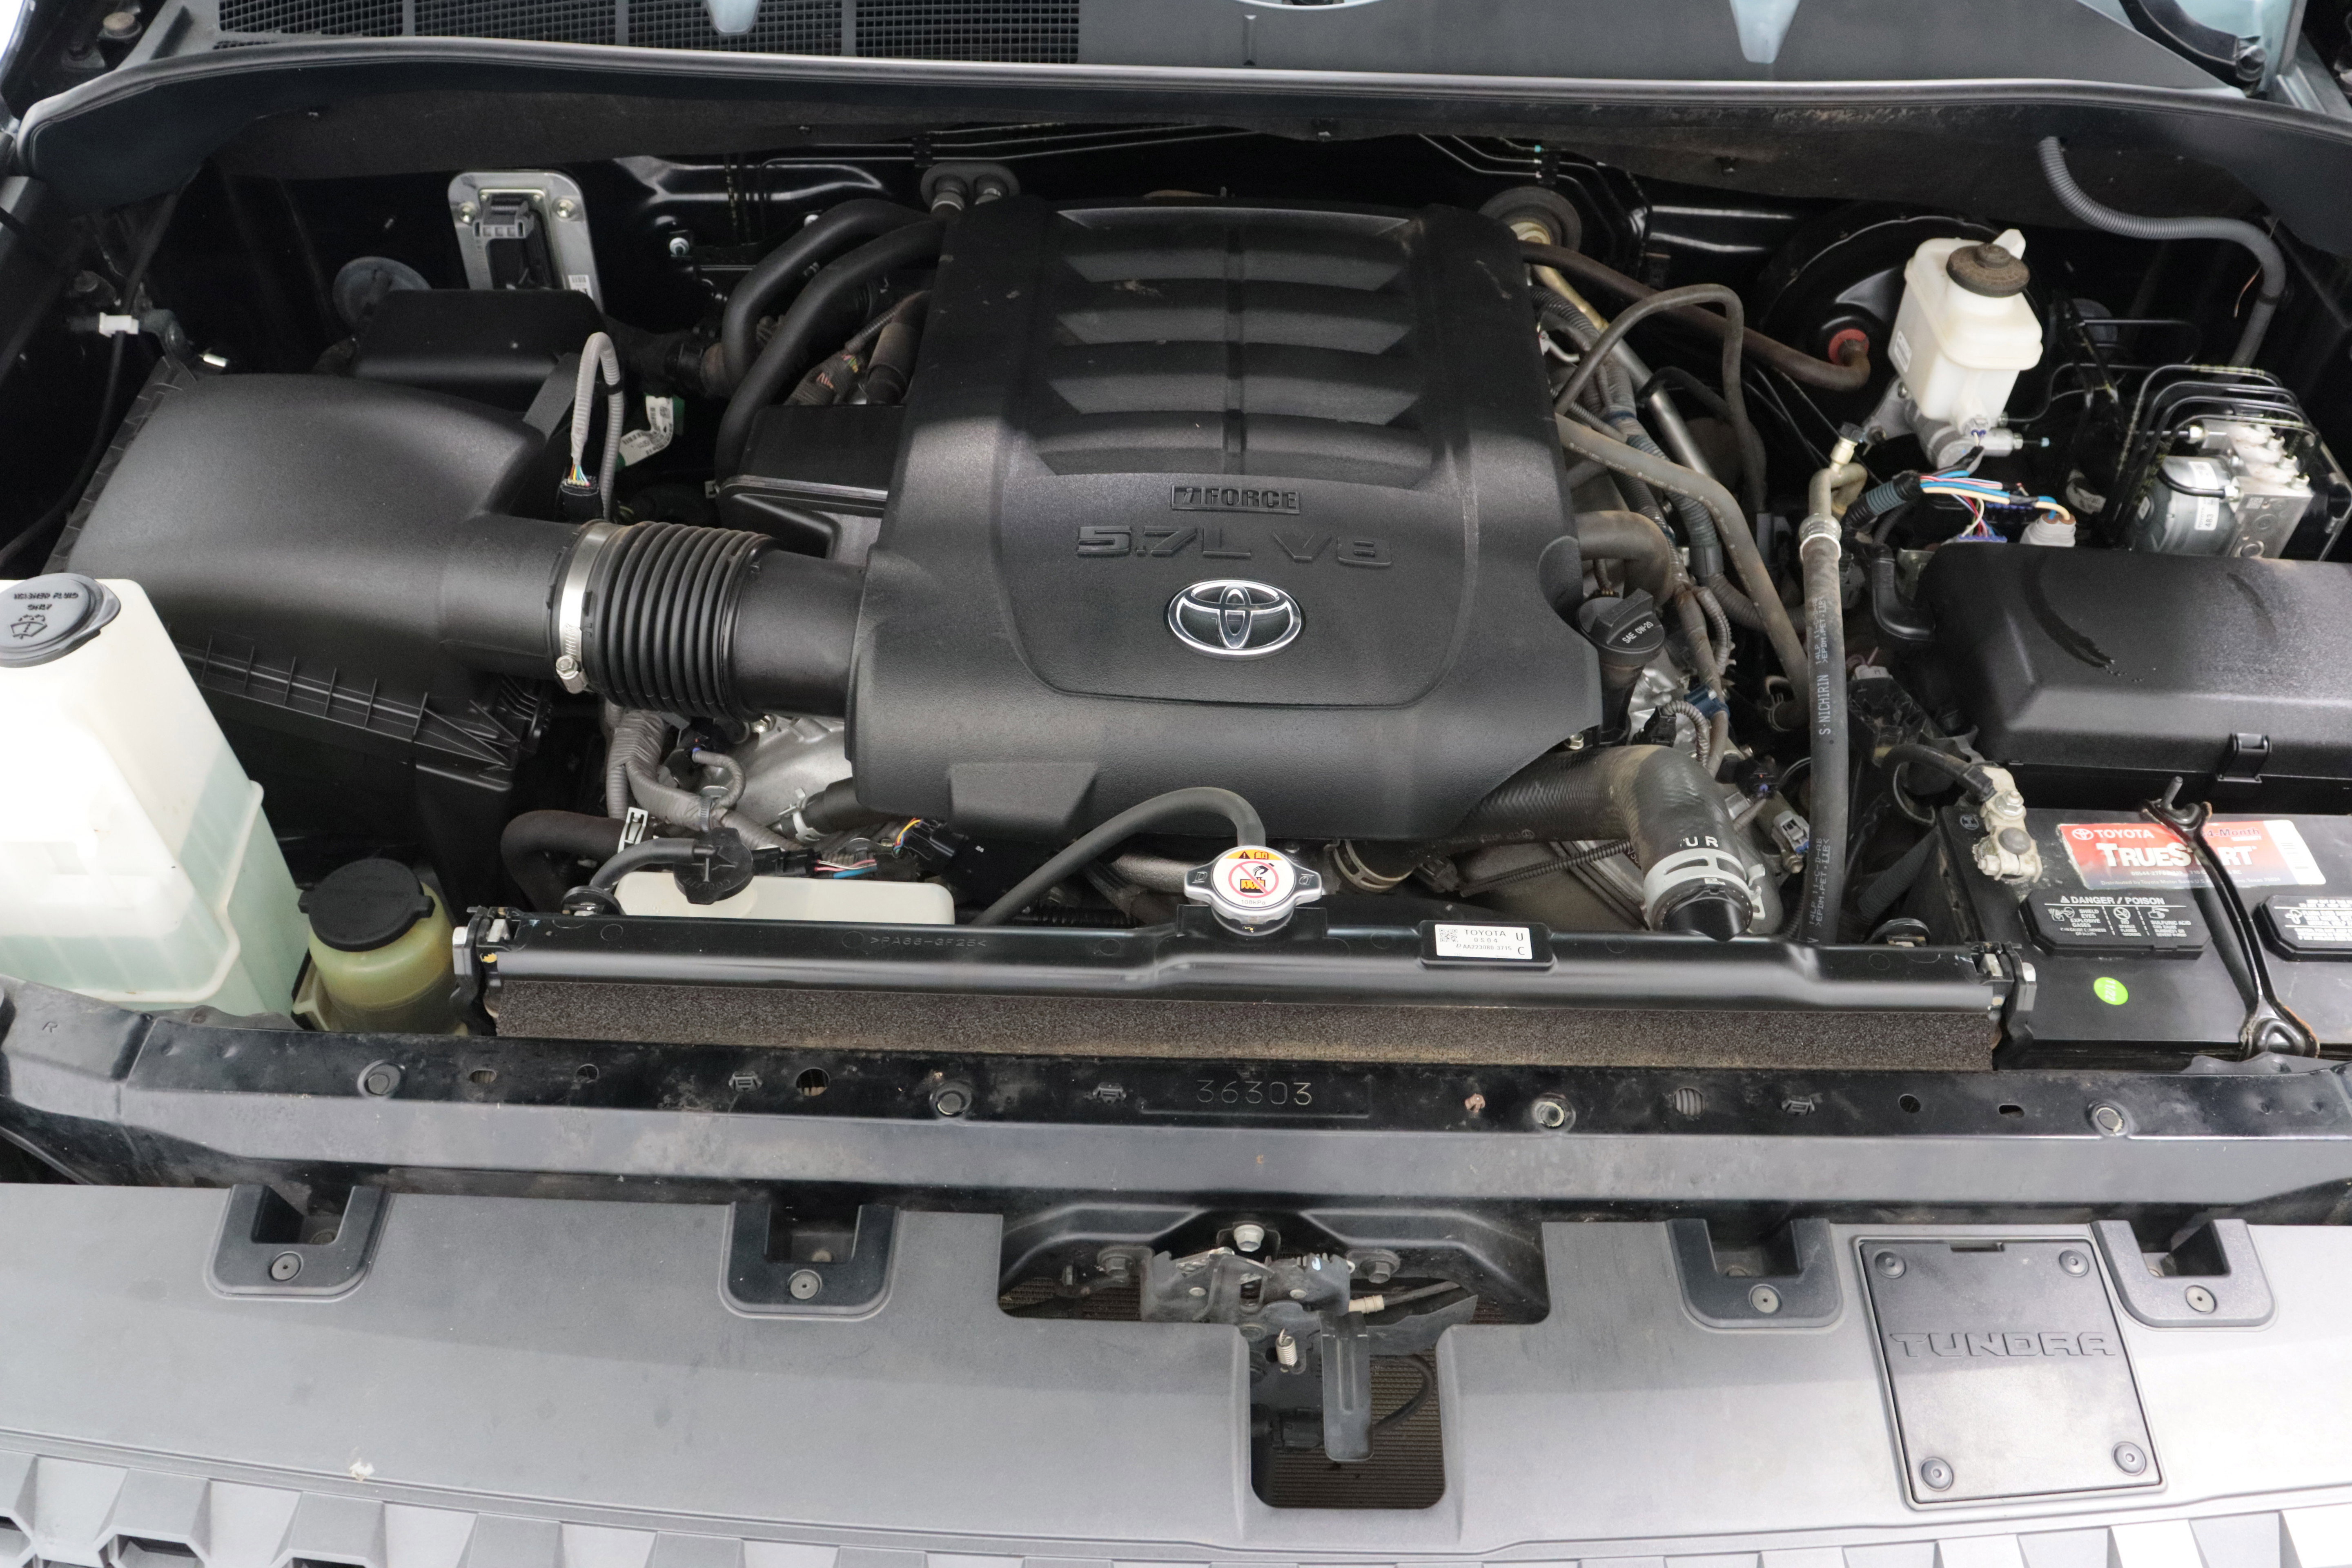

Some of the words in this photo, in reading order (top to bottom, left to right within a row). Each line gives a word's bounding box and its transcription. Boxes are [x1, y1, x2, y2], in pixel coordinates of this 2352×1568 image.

[1077, 526, 1251, 555] 5.7L
[1271, 530, 1392, 565] V8
[1622, 632, 1637, 644] SAE
[1635, 621, 1654, 634] 0W-20
[2094, 829, 2155, 838] TOYOTA
[1516, 932, 1523, 941] U
[1518, 947, 1525, 955] C
[2105, 980, 2116, 1002] 11/22
[1197, 1080, 1312, 1105] 36303
[1889, 1332, 2116, 1357] TUNDRA
